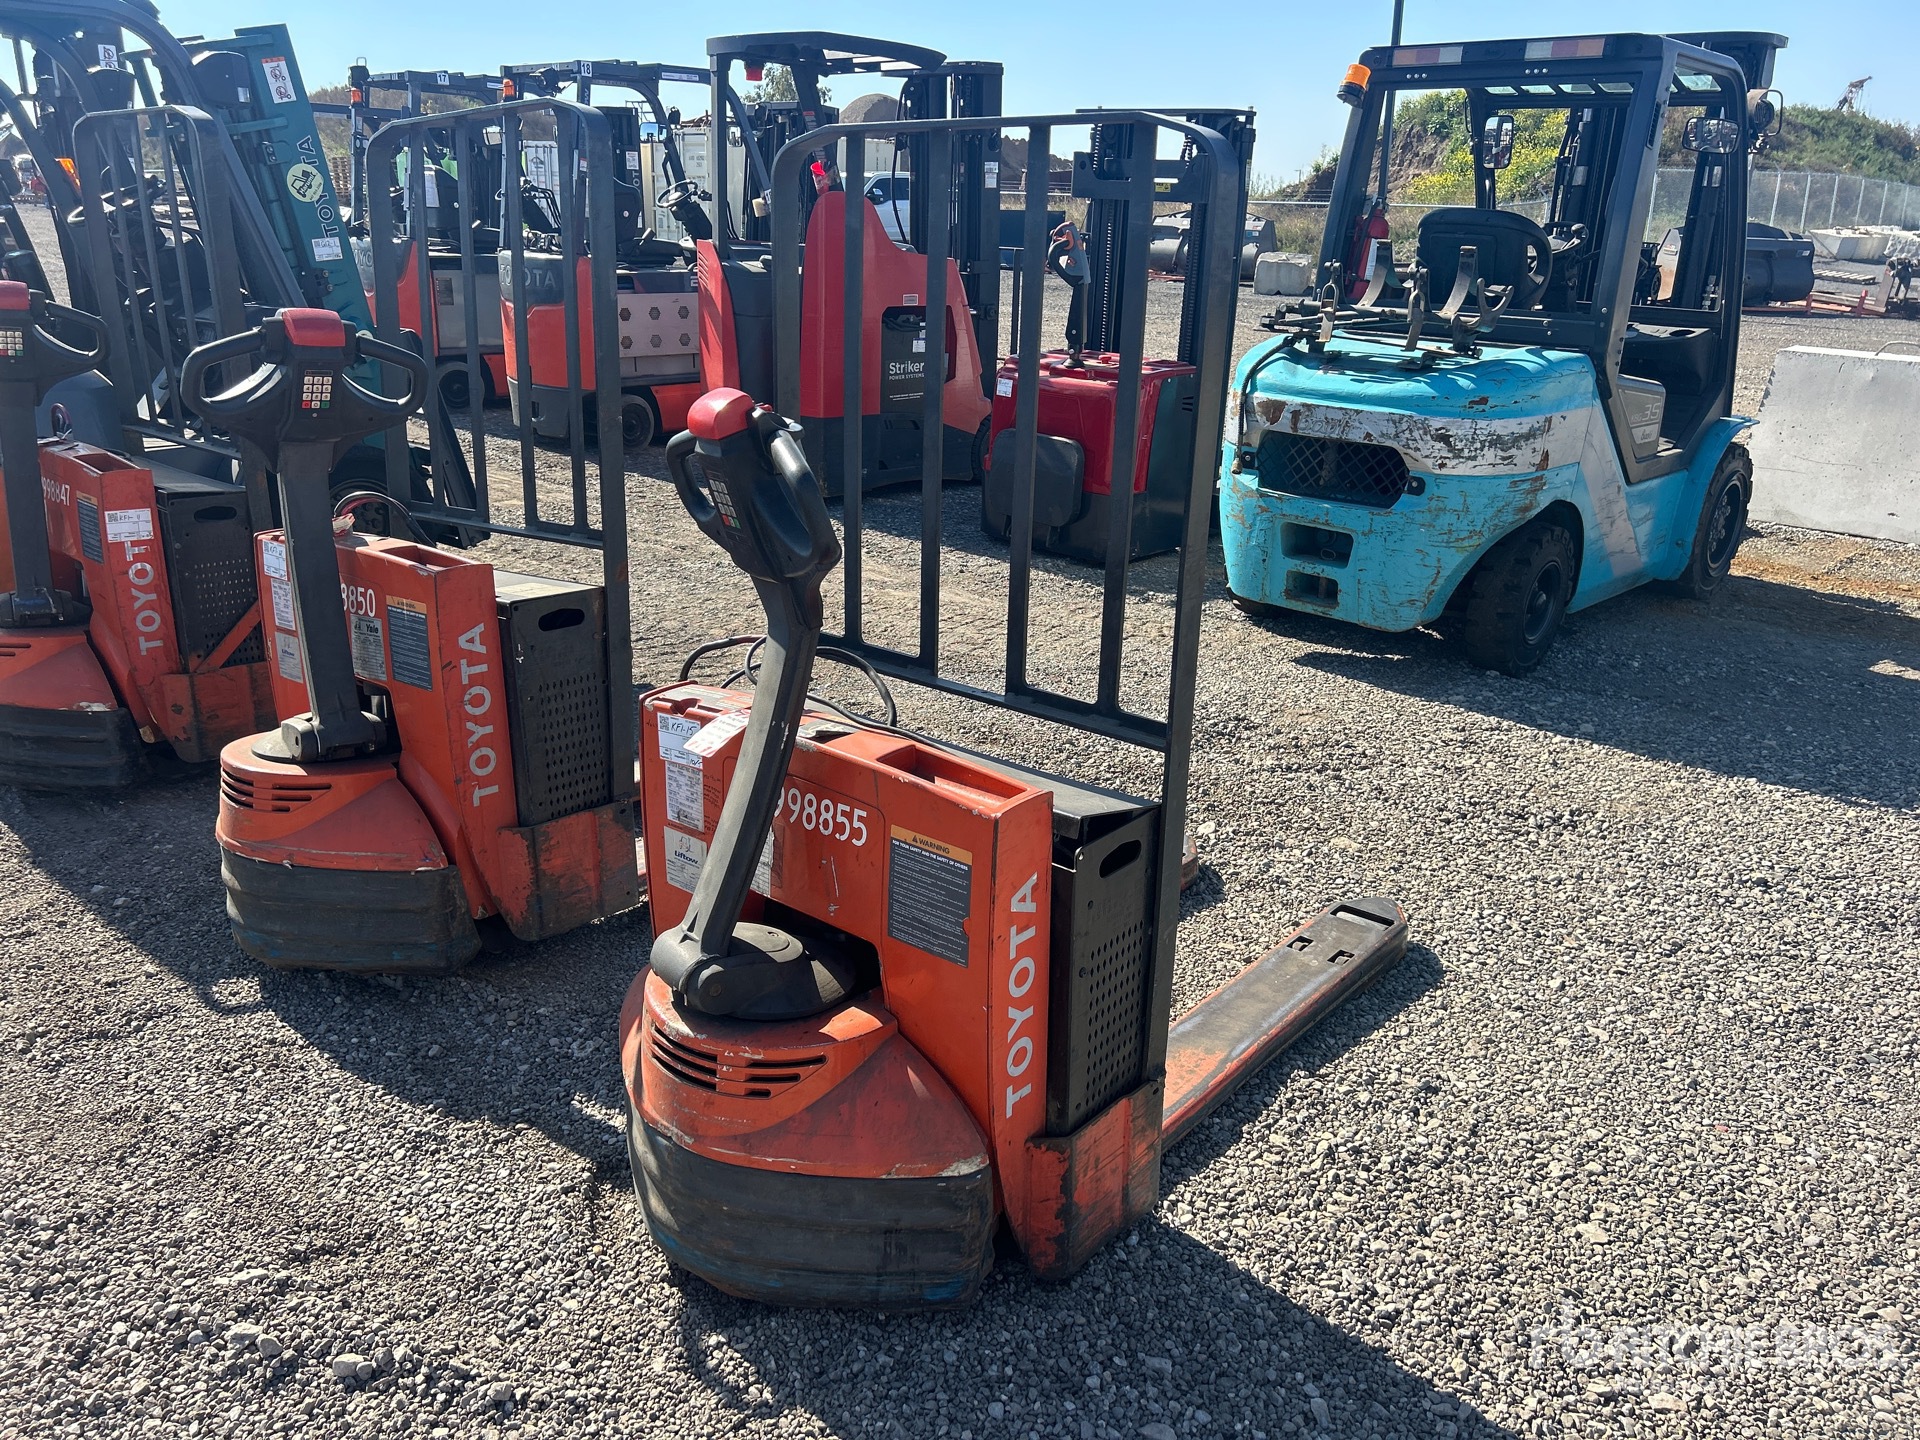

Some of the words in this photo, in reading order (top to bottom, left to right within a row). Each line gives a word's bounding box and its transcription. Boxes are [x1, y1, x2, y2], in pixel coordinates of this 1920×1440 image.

[581, 63, 592, 75] 18
[437, 73, 448, 84] 17
[888, 361, 925, 374] Striker
[1642, 402, 1661, 421] 35
[124, 541, 164, 656] TOYOT
[365, 623, 379, 634] Yale
[458, 622, 499, 807] TOYOTA
[918, 838, 950, 854] WARNING
[674, 849, 699, 865] Liftow
[937, 855, 949, 863] SAFETY
[1006, 871, 1038, 1119] TOYOTA
